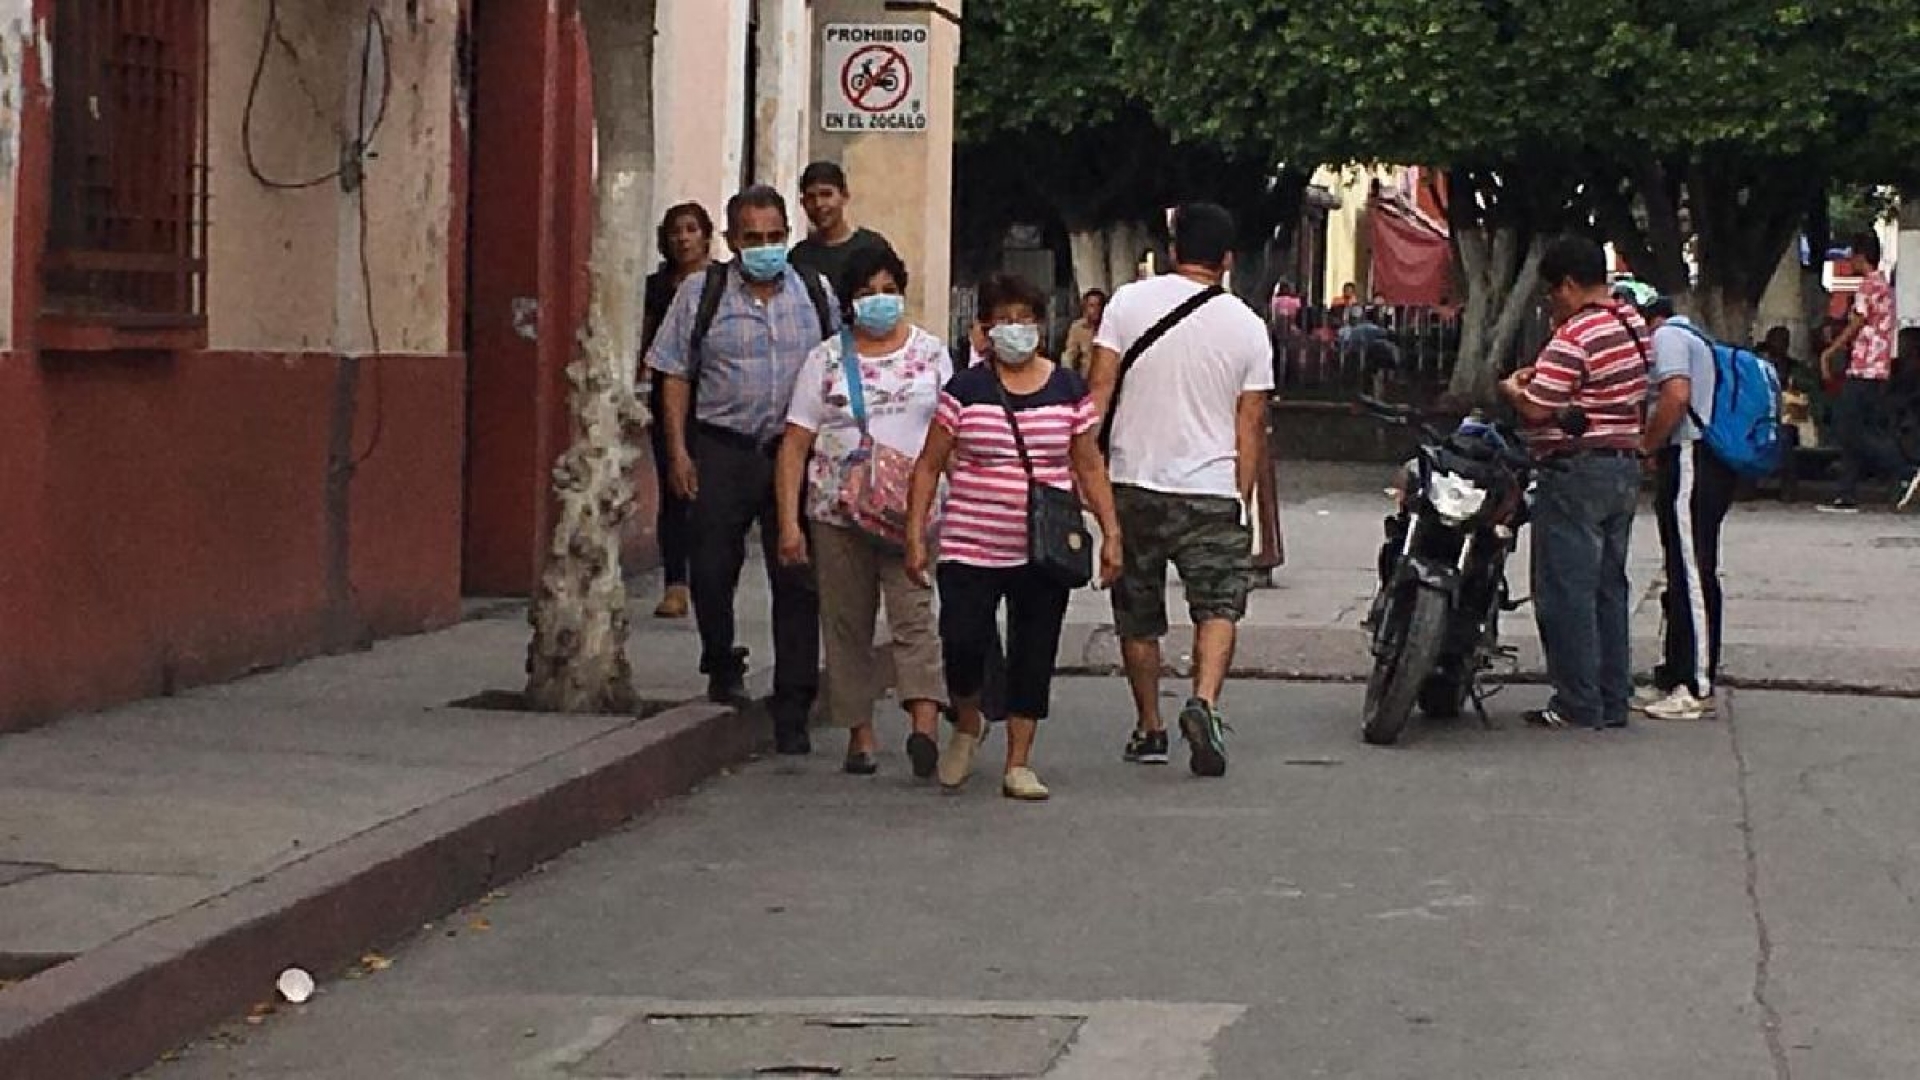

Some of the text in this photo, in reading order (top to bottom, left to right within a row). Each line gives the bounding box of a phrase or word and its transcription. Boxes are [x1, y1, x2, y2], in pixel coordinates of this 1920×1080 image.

[826, 28, 927, 42] PROHIBIDO
[826, 113, 843, 128] EN
[848, 113, 864, 128] EL
